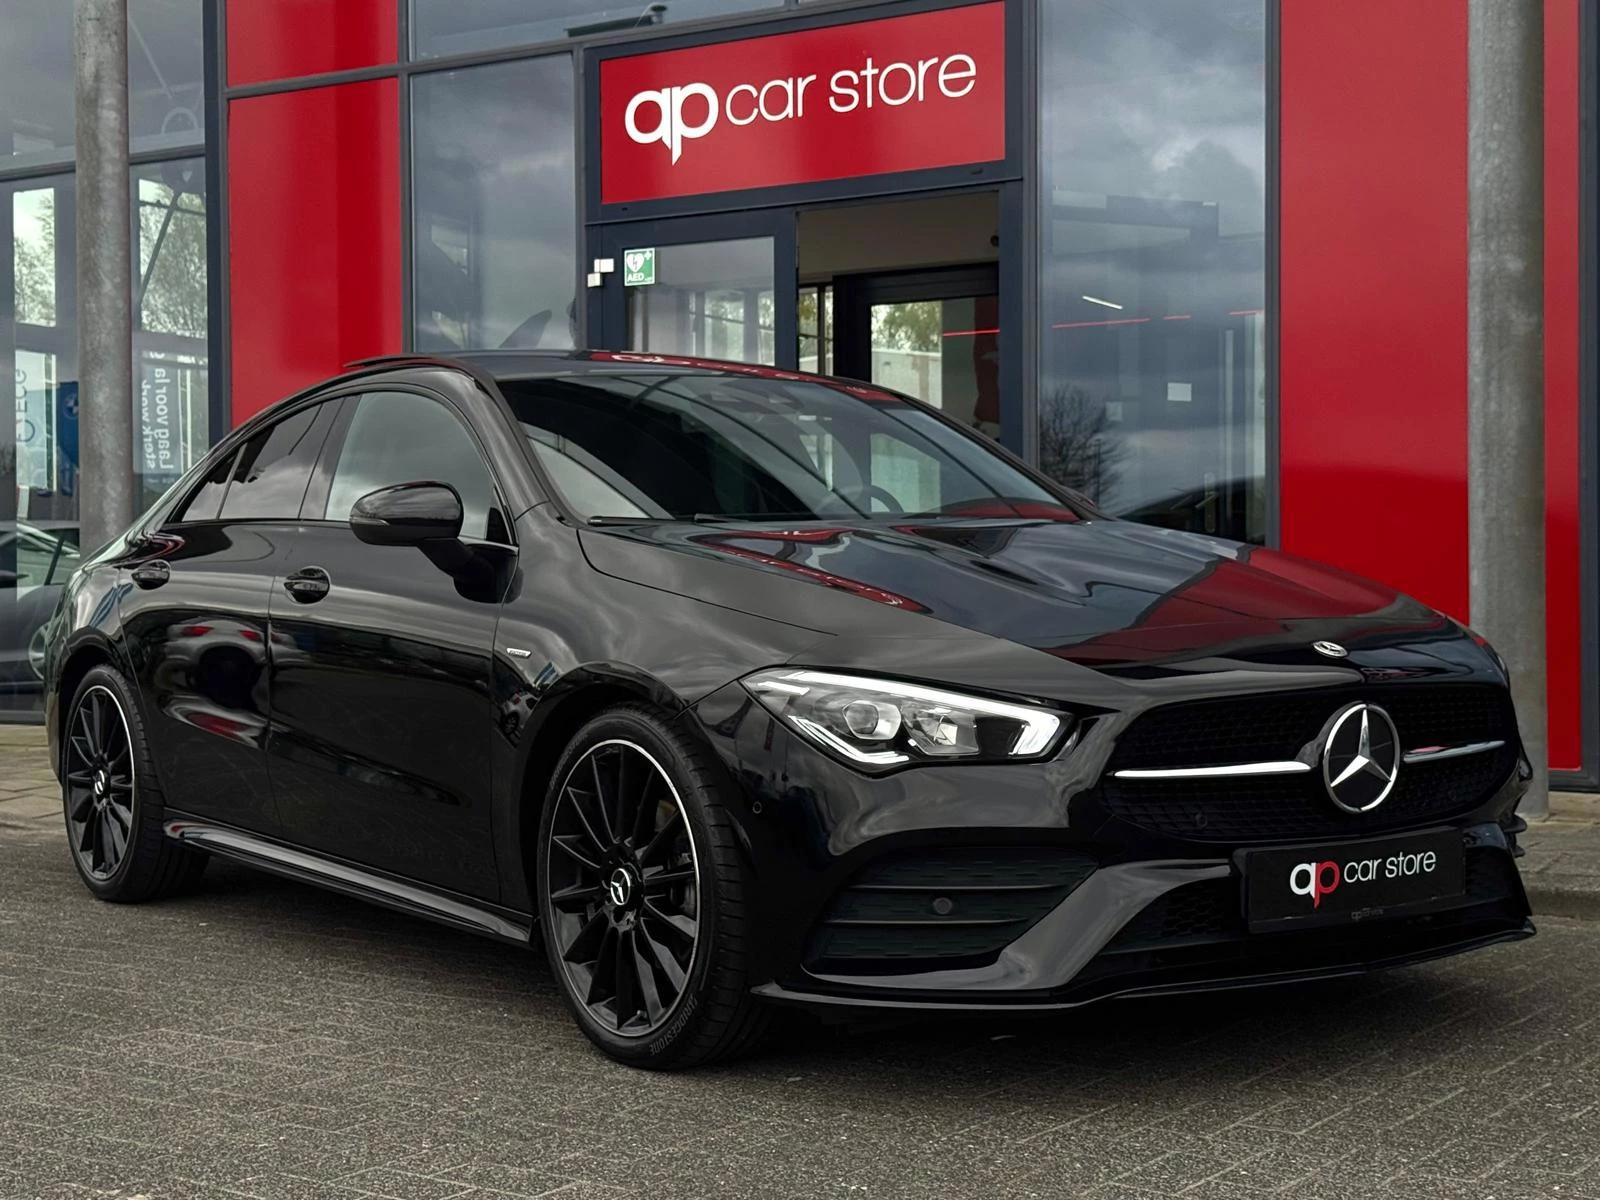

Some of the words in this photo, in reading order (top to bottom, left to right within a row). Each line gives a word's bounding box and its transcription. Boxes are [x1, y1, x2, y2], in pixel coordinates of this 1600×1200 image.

[624, 82, 719, 166] ap
[725, 73, 817, 126] car
[828, 54, 977, 113] store
[627, 272, 645, 282] AED
[1289, 860, 1341, 909] ap
[1343, 857, 1382, 883] car
[1385, 851, 1437, 878] store
